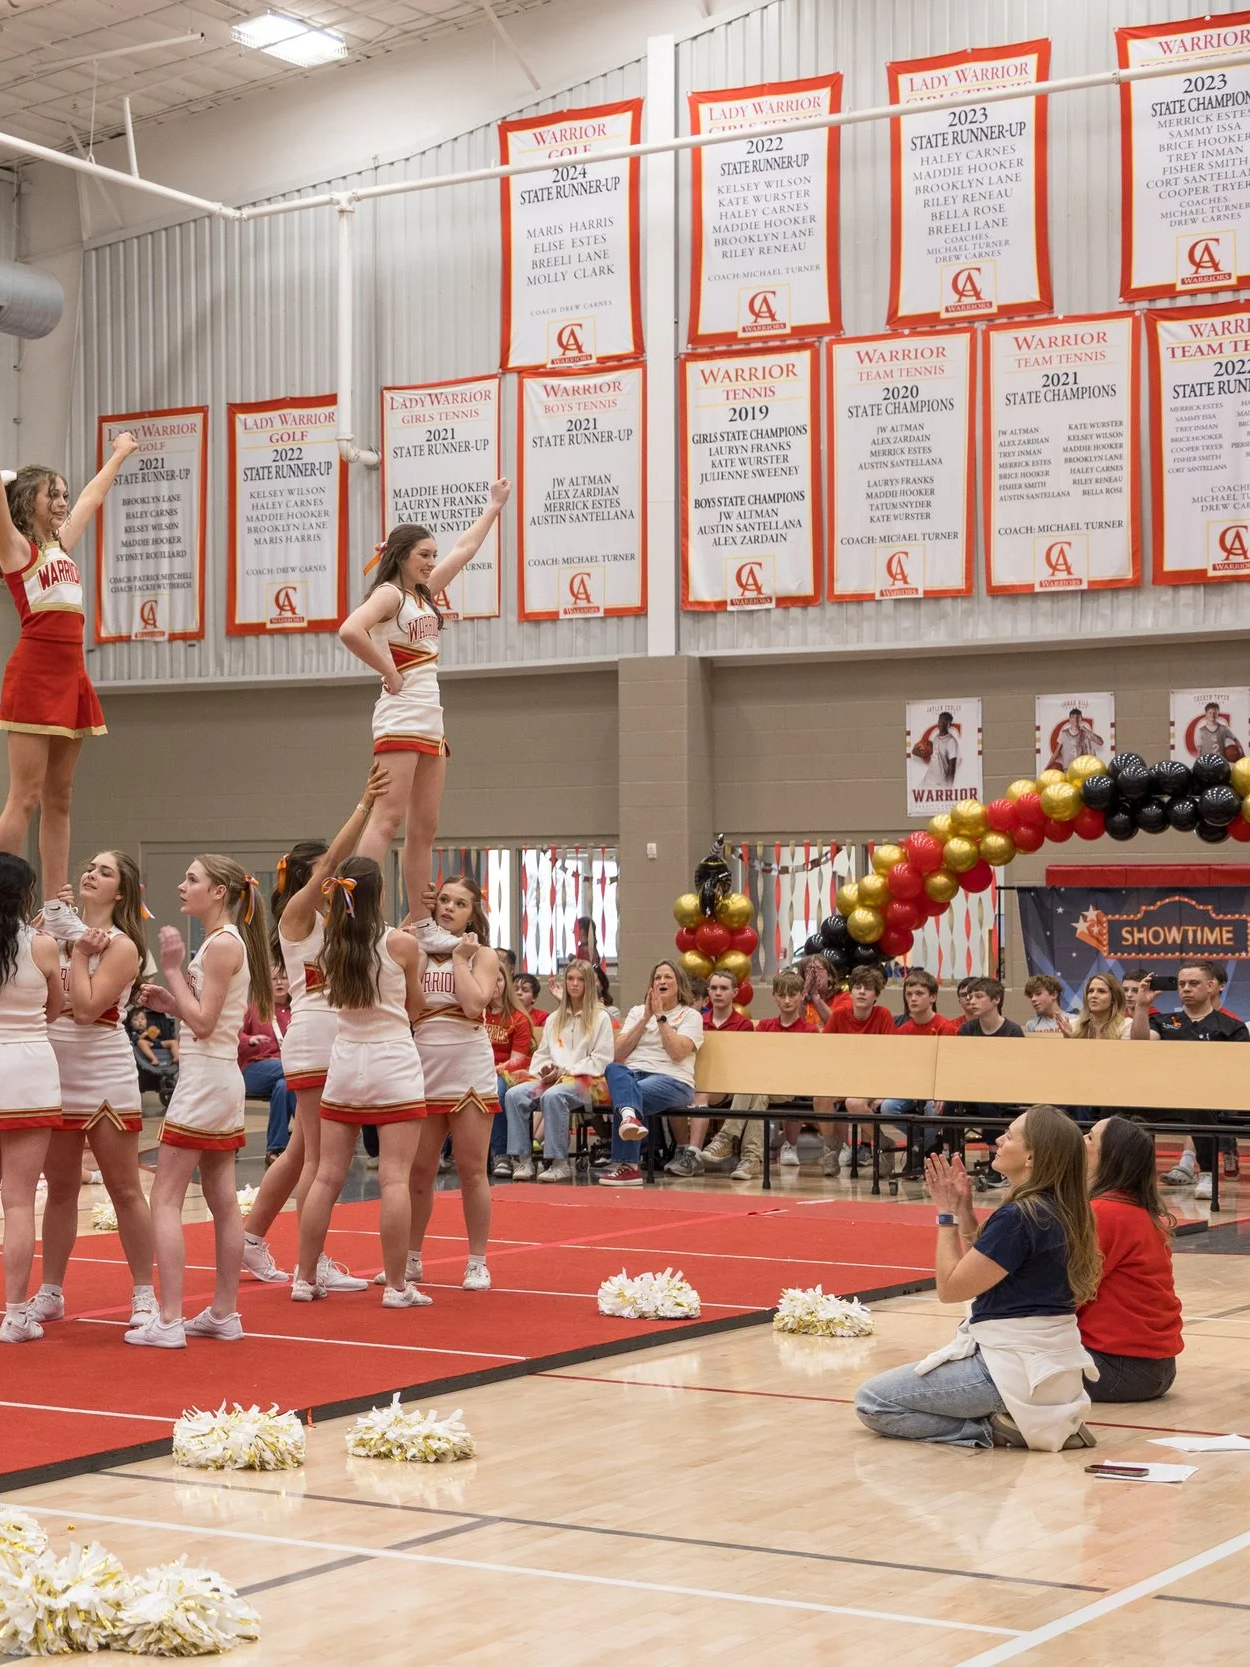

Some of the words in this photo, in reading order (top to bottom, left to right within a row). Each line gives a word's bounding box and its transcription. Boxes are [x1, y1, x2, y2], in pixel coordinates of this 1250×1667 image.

[1159, 29, 1250, 55] WARRIOR
[910, 74, 950, 92] LADY
[955, 62, 1029, 84] WARRIOR
[1183, 73, 1227, 93] 2023
[709, 105, 748, 120] LADY
[752, 96, 821, 115] WARRIOR
[1152, 99, 1186, 118] STATE
[948, 108, 988, 127] 2023
[1158, 113, 1213, 129] MERRICK
[532, 123, 606, 146] WARRIOR
[911, 132, 949, 151] STATE
[953, 122, 1026, 145] RUNNER-UP
[1169, 125, 1213, 139] SAMMY
[1217, 122, 1241, 132] ISSA
[746, 136, 783, 154] 2022
[1159, 141, 1194, 152] BRICE
[1167, 151, 1198, 163] TREY
[1202, 145, 1244, 158] INMAN
[921, 151, 962, 166] HALEY
[966, 144, 1016, 160] CARNES
[552, 164, 587, 183] 2024
[721, 159, 750, 176] STATE
[752, 153, 809, 173] RUNNER-UP
[913, 165, 964, 181] MADDIE
[968, 158, 1024, 174] HOOKER
[1163, 162, 1204, 176] FISHER
[1208, 156, 1247, 169] SMITH
[520, 187, 552, 205] STATE
[556, 176, 620, 199] RUNNER-UP
[718, 182, 761, 195] KELSEY
[765, 176, 811, 189] WILSON
[915, 178, 984, 195] BROOKLYN
[989, 173, 1022, 185] LANE
[1147, 178, 1180, 189] CORT
[1159, 186, 1210, 199] COOPER
[719, 195, 748, 207] KATE
[753, 189, 810, 203] WURSTER
[924, 195, 958, 208] RILEY
[963, 188, 1013, 203] RENEAU
[720, 208, 758, 220] HALEY
[762, 202, 809, 216] CARNES
[931, 208, 969, 221] BELLA
[974, 203, 1005, 216] ROSE
[527, 224, 563, 239] MARIS
[570, 217, 614, 232] HARRIS
[712, 222, 760, 233] MADDIE
[764, 215, 816, 228] HOOKER
[929, 222, 971, 236] BREELI
[975, 217, 1009, 230] LANE
[534, 240, 565, 254] ELISE
[572, 234, 606, 248] ESTES
[714, 233, 779, 246] BROOKLYN
[784, 228, 814, 239] LANE
[532, 255, 572, 269] BREELI
[578, 249, 609, 262] LANE
[722, 247, 755, 259] RILEY
[759, 242, 806, 255] RENEAU
[527, 271, 567, 286] MOLLY
[574, 264, 614, 279] CLARK
[1013, 332, 1108, 351] WARRIOR
[1167, 342, 1224, 359] TEAM
[856, 346, 946, 365] WARRIOR
[1015, 356, 1052, 368] TEAM
[1057, 351, 1106, 365] TENNIS
[701, 363, 797, 385] WARRIOR
[858, 368, 894, 381] TEAM
[898, 365, 945, 378] TENNIS
[1042, 372, 1079, 388] 2021
[543, 381, 622, 398] WARRIOR
[723, 385, 776, 401] TENNIS
[883, 385, 919, 400] 2020
[1005, 391, 1041, 406] STATE
[1044, 384, 1117, 402] CHAMPIONS
[1173, 382, 1215, 399] STATE
[390, 396, 427, 410] LADY
[428, 389, 491, 406] WARRIOR
[544, 403, 573, 413] BOYS
[576, 399, 617, 411] TENNIS
[848, 404, 882, 418] STATE
[885, 398, 954, 415] CHAMPIONS
[244, 417, 276, 430] LADY
[279, 412, 335, 426] WARRIOR
[402, 412, 435, 424] GIRLS
[438, 408, 479, 421] TENNIS
[729, 405, 769, 422] 2019
[142, 423, 197, 438] WARRIOR
[567, 418, 597, 432] 2021
[692, 433, 718, 444] GIRLS
[720, 430, 748, 442] STATE
[750, 424, 807, 440] CHAMPIONS
[270, 431, 308, 444] GOLF
[426, 428, 455, 442] 2021
[532, 435, 565, 448] STATE
[568, 429, 632, 446] RUNNER-UP
[139, 442, 165, 452] GOLF
[272, 447, 303, 462] 2022
[393, 445, 425, 459] STATE
[428, 439, 489, 456] RUNNER-UP
[709, 445, 748, 456] LAURYN
[751, 441, 791, 453] FRANKS
[139, 458, 165, 471] 2021
[712, 458, 736, 468] KATE
[739, 454, 789, 466] WURSTER
[114, 473, 140, 486] STATE
[142, 469, 191, 483] RUNNER-UP
[243, 465, 273, 482] STATE
[275, 461, 332, 479] RUNNER-UP
[700, 469, 749, 484] JULIENNE
[752, 465, 799, 478] SWEENEY
[393, 486, 438, 499] MADDIE
[442, 481, 489, 494] HOOKER
[553, 478, 566, 489] JW
[569, 474, 611, 486] ALTMAN
[546, 490, 570, 500] ALEX
[573, 486, 619, 498] ZARDIAN
[694, 498, 716, 509] BOYS
[717, 495, 746, 507] STATE
[748, 490, 805, 505] CHAMPIONS
[395, 498, 440, 511] LAURYN
[444, 494, 488, 506] FRANKS
[544, 500, 589, 513] MERRICK
[592, 498, 620, 509] ESTES
[398, 511, 427, 523] KATE
[430, 507, 484, 520] WURSTER
[719, 511, 734, 522] JW
[737, 508, 779, 520] ALTMAN
[698, 524, 733, 535] AUSTIN
[736, 519, 802, 533] SANTELLANA
[998, 525, 1035, 536] COACH:
[1038, 522, 1082, 534] MICHAEL
[1084, 520, 1124, 530] TURNER
[712, 536, 737, 546] ALEX
[741, 533, 788, 545] ZARDAIN
[912, 788, 978, 803] WARRIOR
[1121, 926, 1234, 945] SHOWTIME
